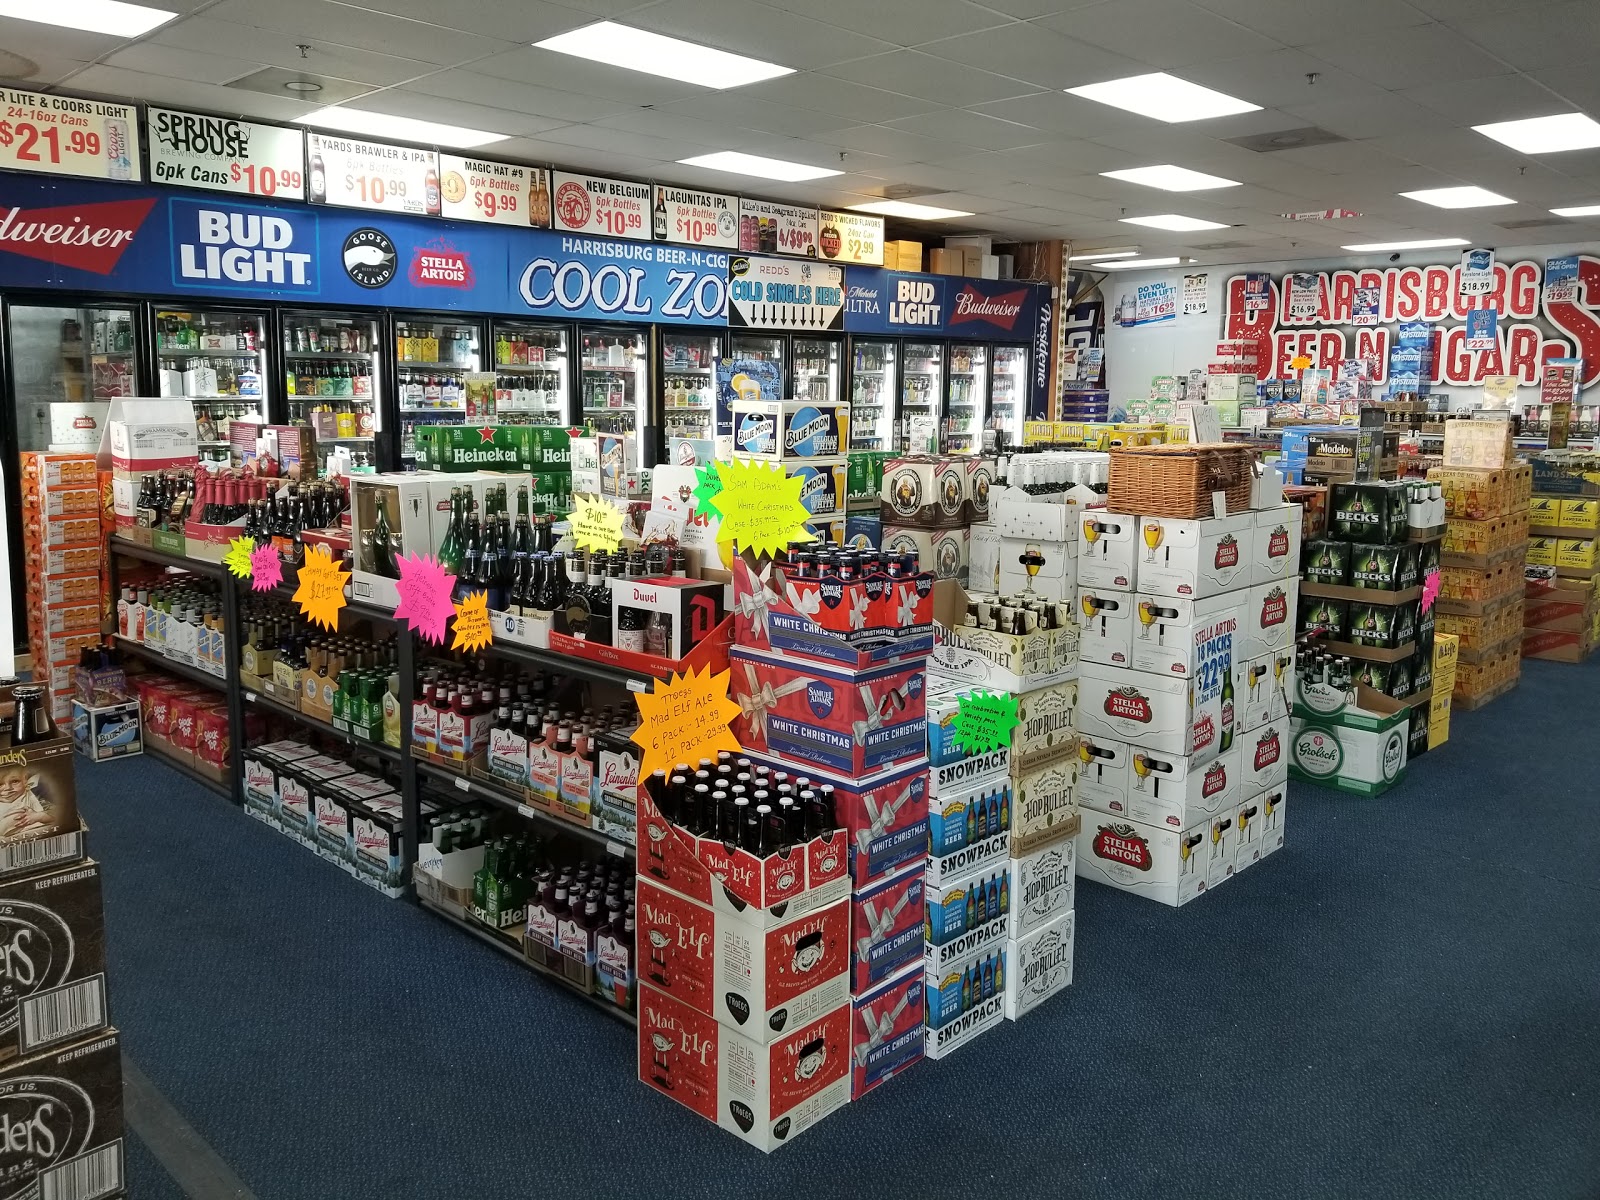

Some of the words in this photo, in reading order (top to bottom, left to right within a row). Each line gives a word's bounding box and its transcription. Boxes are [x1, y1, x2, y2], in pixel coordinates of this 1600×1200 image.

[10, 93, 35, 109] LITE
[40, 96, 48, 108] &
[52, 99, 93, 115] COORS
[96, 104, 129, 119] LIGHT
[7, 106, 57, 123] 24-16oz
[60, 113, 89, 128] Cans
[157, 112, 241, 143] SPRING
[0, 119, 101, 164] $21.99
[175, 132, 249, 159] HOUSE
[322, 138, 352, 154] YARDS
[354, 144, 399, 161] BRAWLER
[401, 151, 408, 161] &
[411, 153, 426, 163] IPA
[155, 161, 186, 180] 6pk
[190, 165, 229, 186] Cans
[230, 162, 301, 196] $10.99
[464, 161, 490, 174] MAGIC
[492, 164, 509, 177] HAT
[511, 167, 523, 179] #9
[345, 175, 407, 204] $10.99
[469, 175, 486, 191] 6pk
[488, 177, 520, 193] Bottles
[586, 180, 607, 194] NEW
[609, 183, 650, 200] BELGIUM
[474, 191, 517, 217] $9.99
[595, 196, 611, 210] 6pk
[613, 197, 641, 211] Bottles
[665, 190, 712, 208] LAGUNITAS
[714, 196, 728, 210] IPA
[676, 205, 691, 219] 6pk
[692, 207, 717, 220] Bottles
[839, 215, 859, 224] WICKED
[859, 218, 881, 228] FLAVORS
[199, 209, 293, 249] BUD
[596, 210, 642, 235] $10.99
[352, 233, 388, 249] GOOSE
[676, 222, 717, 242] $10.99
[562, 237, 652, 262] HARRISBURG
[848, 240, 874, 260] $2.99
[180, 243, 311, 285] LIGHT
[420, 256, 464, 271] STELLA
[759, 265, 790, 276] REDD'S
[1547, 259, 1568, 267] CRACK
[353, 269, 390, 285] ISLAND
[420, 268, 465, 281] ARTOIS
[519, 257, 650, 313] COOL
[659, 268, 728, 319] ZO
[732, 280, 763, 302] COLD
[766, 282, 812, 305] SINGLES
[815, 286, 841, 307] HERE
[898, 280, 935, 304] BUD
[1137, 286, 1149, 294] DO
[1150, 281, 1167, 291] YOU
[1461, 282, 1490, 292] $18.99
[955, 292, 1021, 317] Budweiser
[1138, 292, 1158, 301] EVEN
[889, 302, 940, 326] LIGHT
[1291, 305, 1316, 315] $16.99
[1399, 330, 1428, 339] KEYSTONE
[1036, 302, 1052, 388] Presidente
[1390, 353, 1421, 362] KEYSTONE
[737, 430, 754, 447] BLUE
[755, 419, 774, 437] MOON
[785, 427, 807, 450] BLUE
[808, 414, 829, 435] MOON
[812, 434, 838, 443] BELGIAN
[812, 441, 838, 451] WHITE
[1320, 442, 1349, 454] Modelo
[807, 475, 827, 493] MOON
[1335, 510, 1379, 524] BECK'S
[1390, 512, 1408, 524] BECK'S
[1218, 554, 1235, 564] ARTOIS
[1219, 547, 1236, 557] STELLA
[1307, 566, 1343, 577] BECK'S
[1354, 571, 1391, 583] BECK'S
[820, 583, 842, 595] SAMUEL
[822, 590, 842, 599] ADAMS
[866, 581, 883, 590] SAMUEL
[866, 586, 883, 594] ADAMS
[633, 587, 657, 604] Duvel
[850, 631, 862, 640] WHITE
[862, 628, 886, 639] CHRISTMAS
[1195, 628, 1214, 646] STELLA
[1214, 618, 1237, 637] ARTOIS
[1197, 645, 1206, 662] 18
[1206, 634, 1232, 655] PACKS
[855, 677, 882, 688] SEASONAL
[650, 711, 670, 729] Mad
[673, 701, 691, 717] Elf
[695, 693, 713, 710] Ale
[178, 717, 193, 728] SHOCK
[1023, 708, 1074, 742] HOPBULLET
[772, 718, 799, 735] WHITE
[801, 728, 850, 749] CHRISTMAS
[942, 744, 961, 756] BEER
[1298, 743, 1339, 764] Grolsch
[938, 750, 1008, 786] SNOWPACK
[944, 833, 963, 846] BEER
[940, 835, 1008, 875] SNOWPACK
[35, 878, 52, 890] KEEP
[52, 868, 98, 886] REFRIGERATED.
[704, 853, 730, 870] Mad
[732, 866, 756, 887] Elf
[944, 920, 962, 934] BEER
[940, 917, 1007, 963] SNOWPACK
[726, 996, 748, 1012] TROEGS
[937, 996, 1002, 1046] SNOWPACK
[57, 1052, 73, 1064] KEEP
[74, 1037, 118, 1058] REFRIGERATED.
